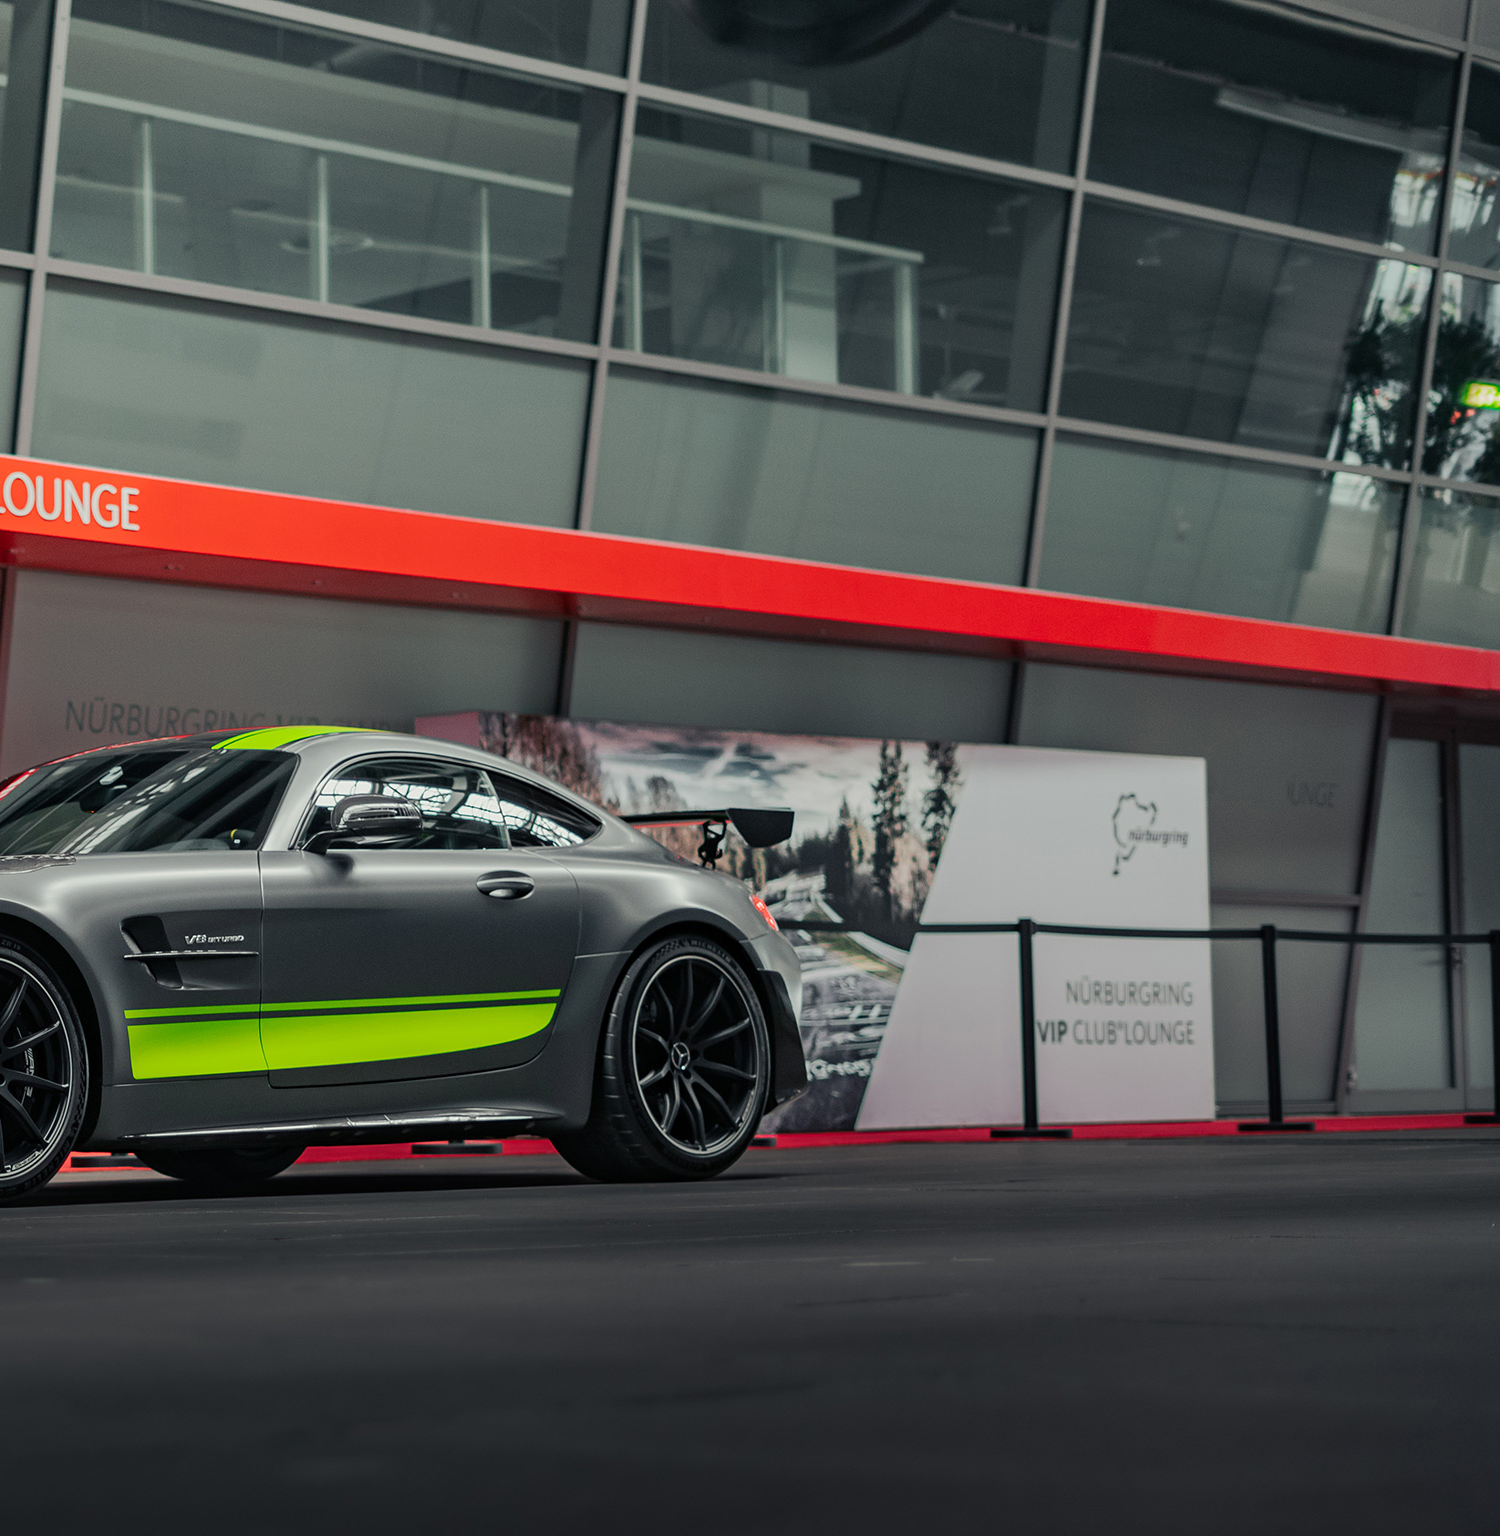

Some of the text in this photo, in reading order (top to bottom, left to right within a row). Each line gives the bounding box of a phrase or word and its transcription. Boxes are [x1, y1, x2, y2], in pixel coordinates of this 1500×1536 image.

[1128, 826, 1189, 847] nürburgring
[184, 934, 207, 945] V8
[1065, 975, 1194, 1007] NÜRBURGRING
[1037, 1019, 1068, 1045] VIP
